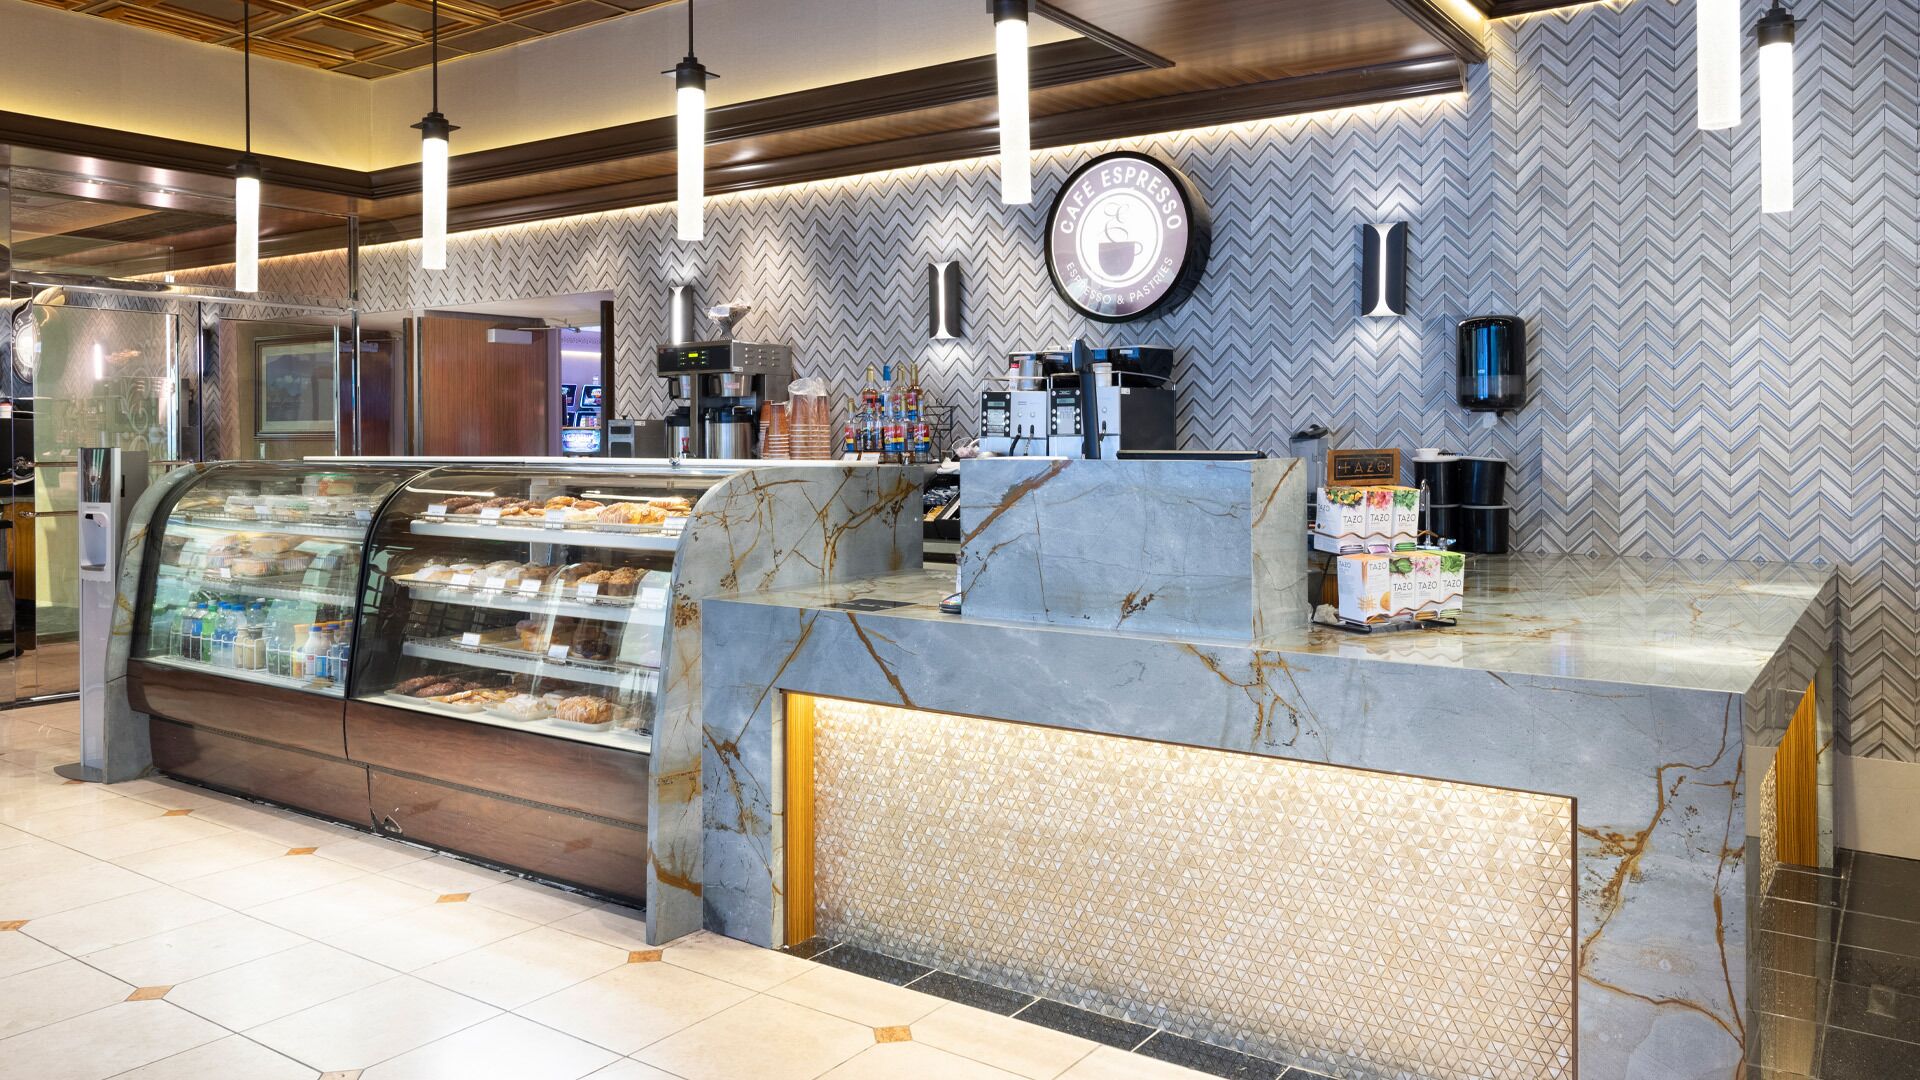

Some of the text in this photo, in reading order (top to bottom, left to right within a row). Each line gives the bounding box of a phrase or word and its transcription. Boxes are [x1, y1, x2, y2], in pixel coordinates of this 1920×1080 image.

[1060, 166, 1182, 234] CAFE ESPRESSO
[1066, 257, 1173, 305] ESPRESSO & PASTRIES
[1343, 515, 1363, 524] TAZO
[1370, 513, 1390, 522] TAZO
[1397, 513, 1417, 522] TAZO
[1369, 561, 1388, 570] TAZO
[1393, 582, 1413, 591] TAZO
[1418, 581, 1438, 590] TAZO
[1442, 579, 1462, 588] TAZO
